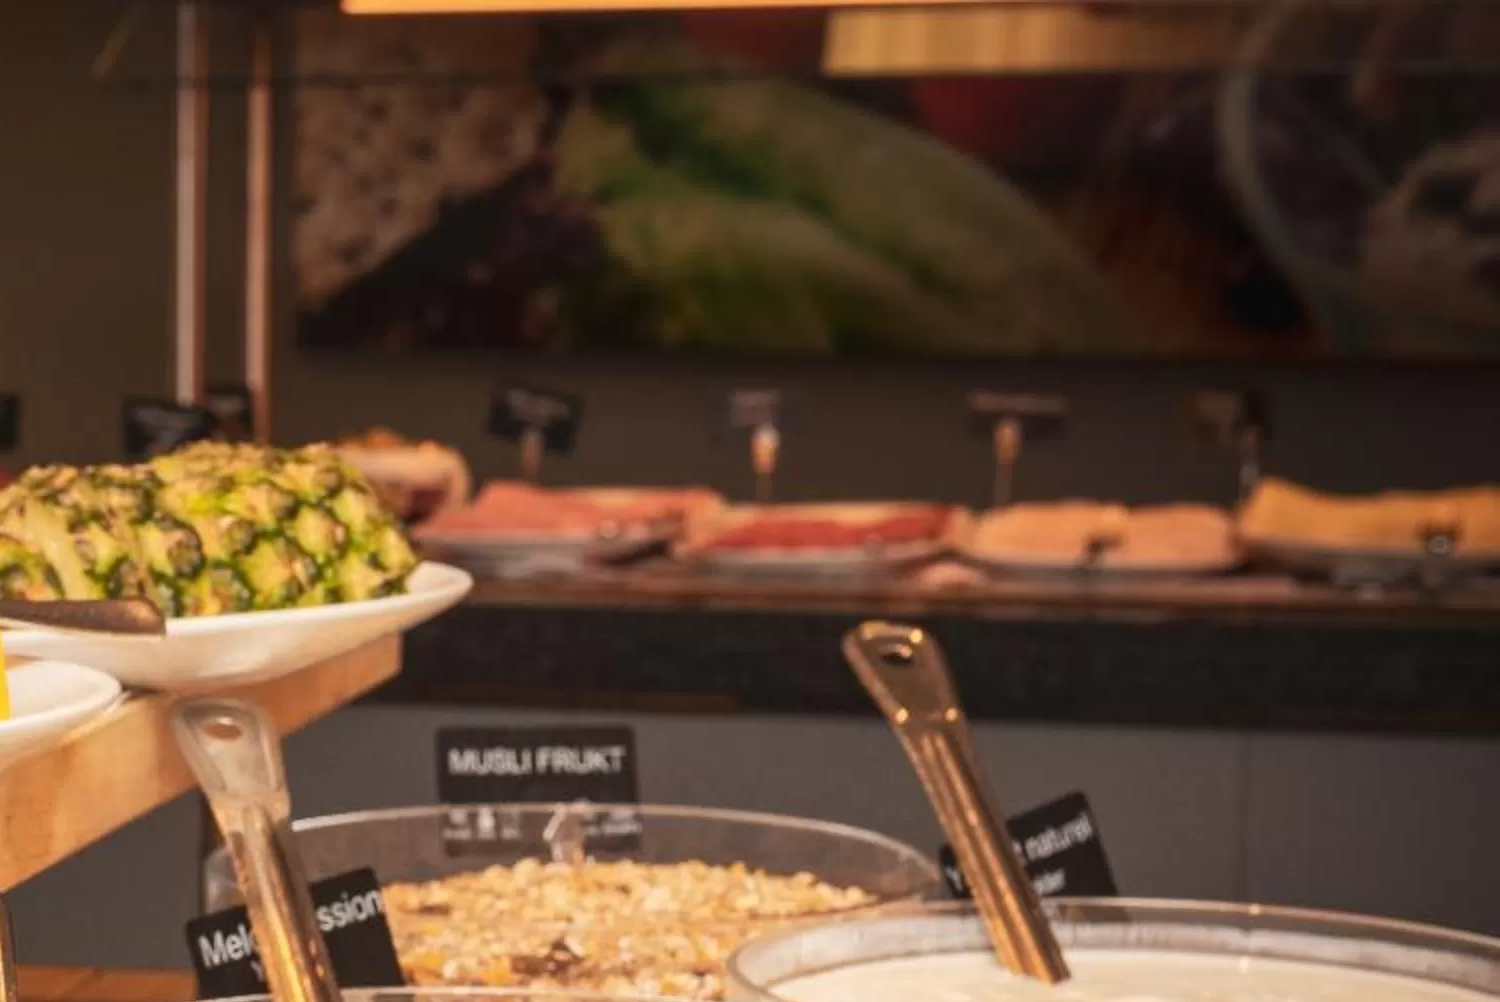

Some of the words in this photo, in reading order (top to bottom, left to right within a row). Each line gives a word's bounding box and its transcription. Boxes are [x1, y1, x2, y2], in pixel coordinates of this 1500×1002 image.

[535, 744, 627, 776] FRUKT
[199, 922, 257, 970] Mel
[315, 890, 382, 933] ssion
